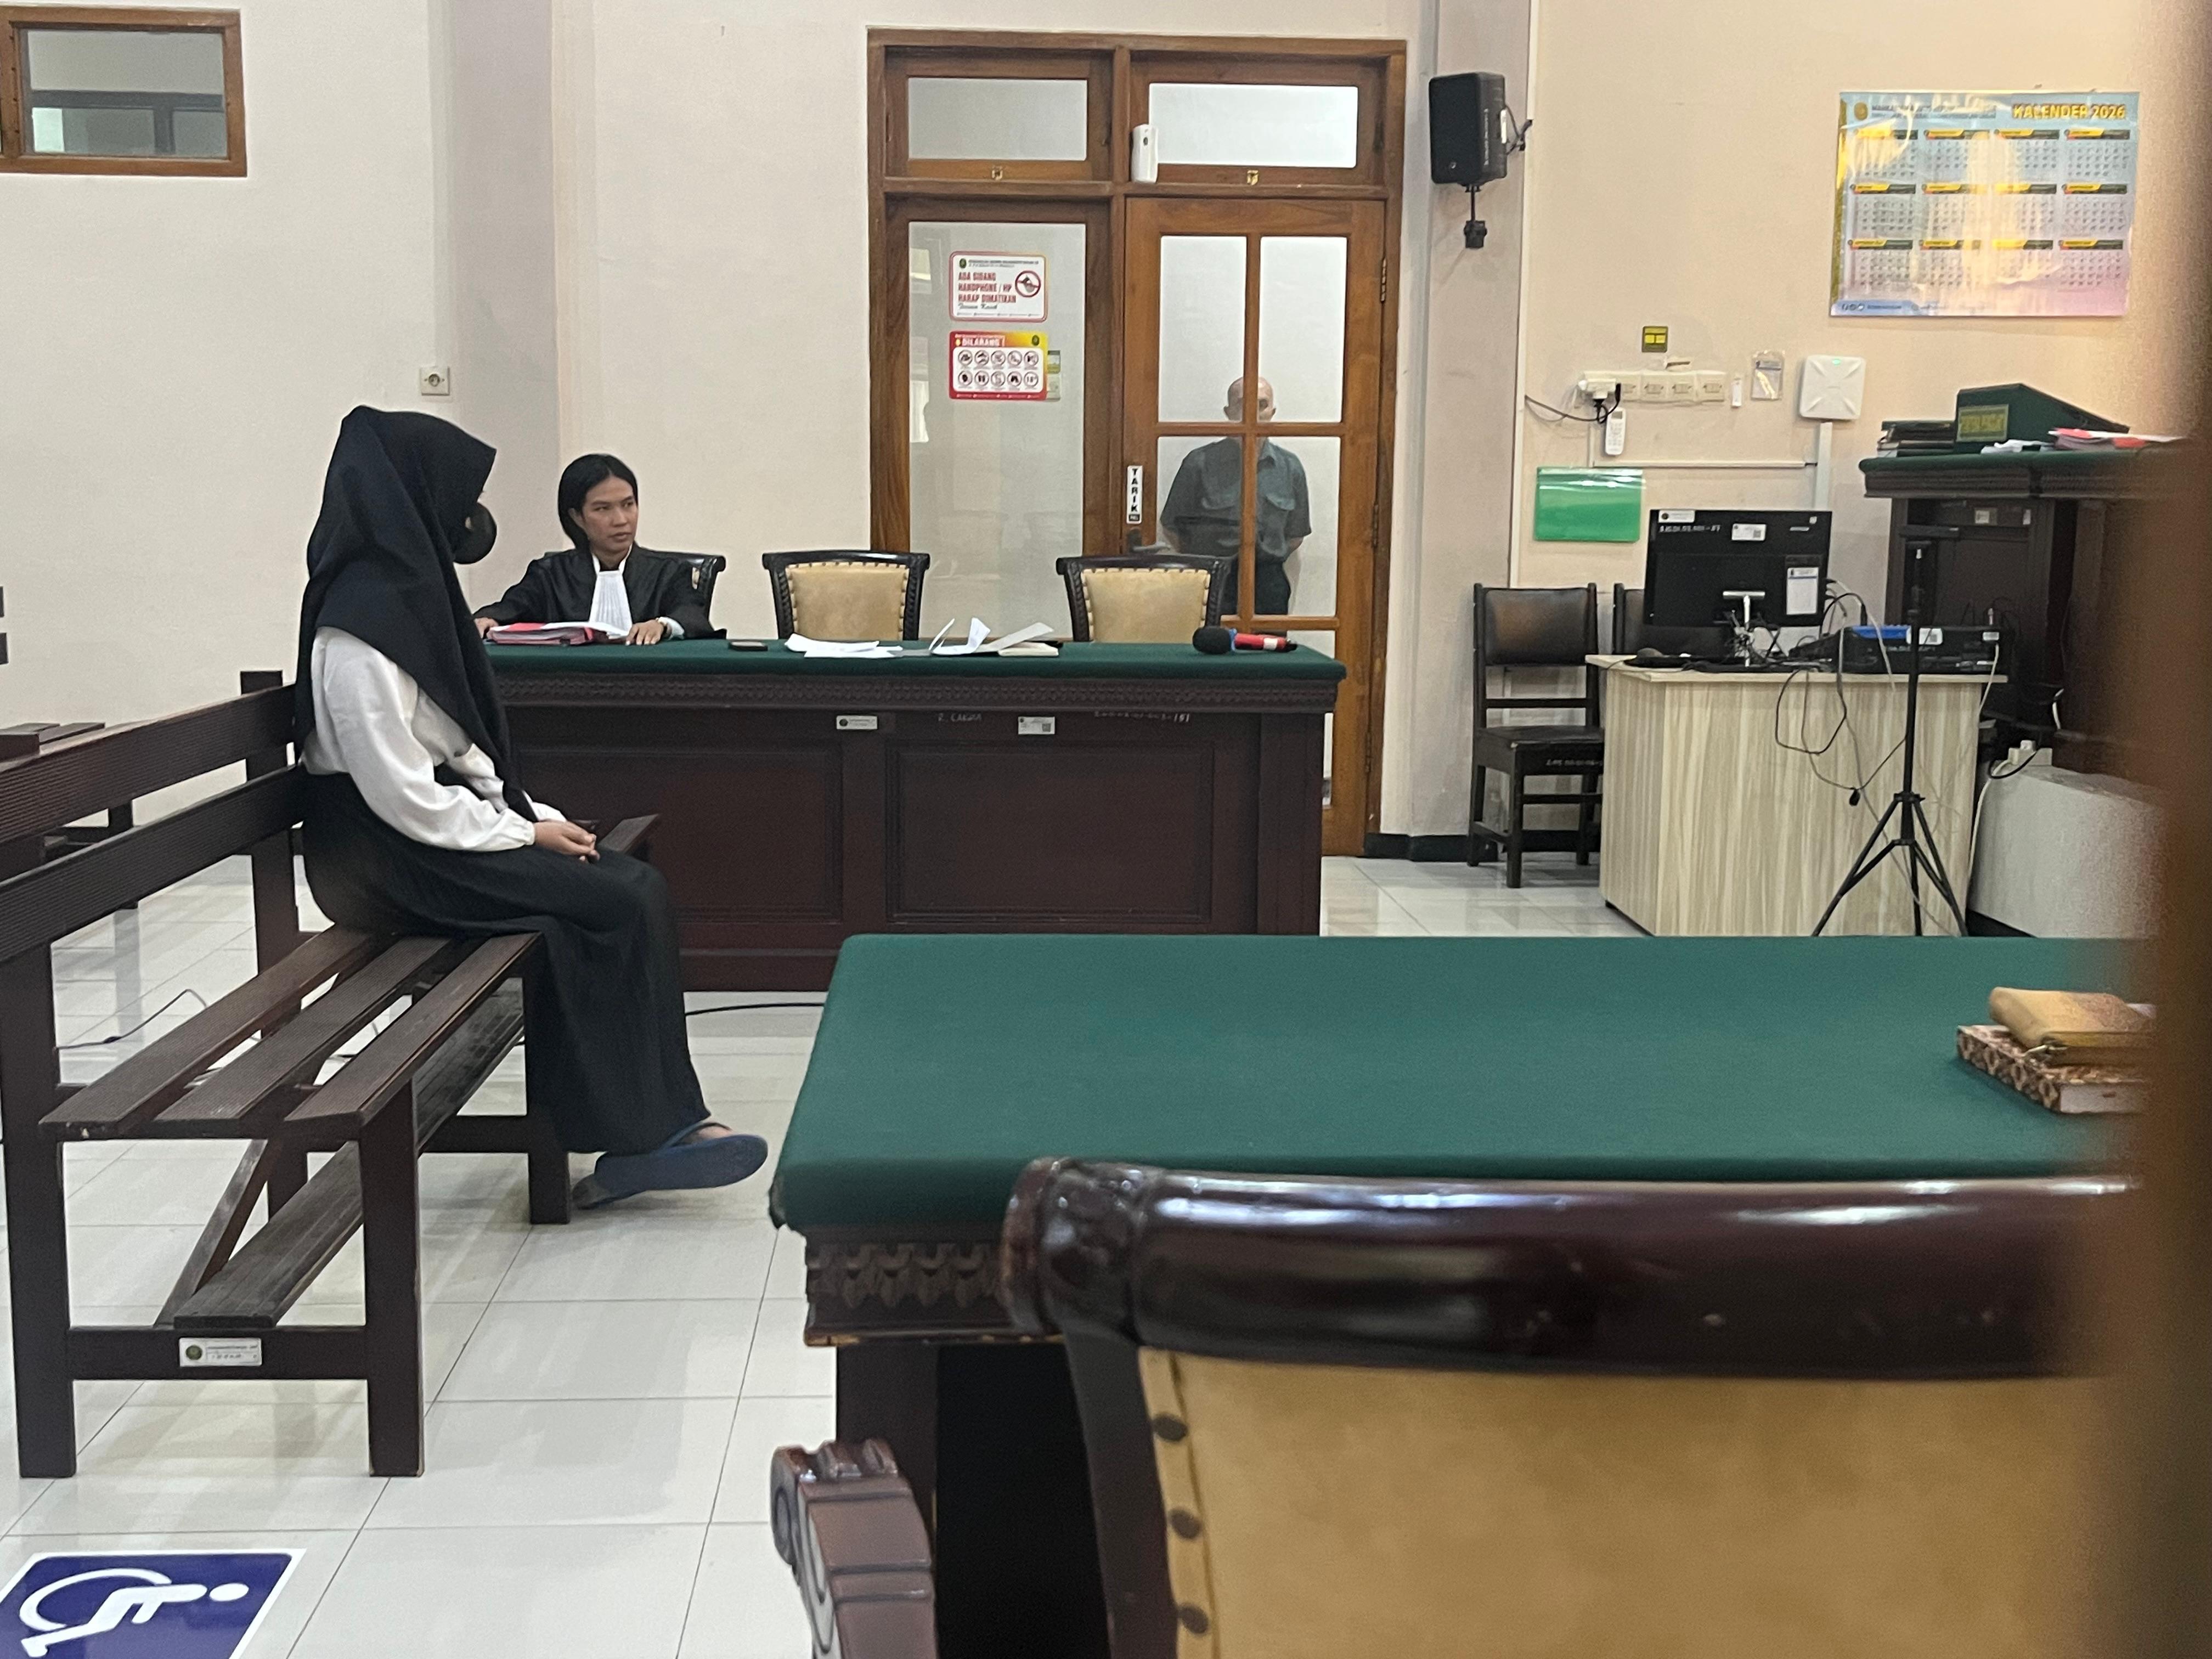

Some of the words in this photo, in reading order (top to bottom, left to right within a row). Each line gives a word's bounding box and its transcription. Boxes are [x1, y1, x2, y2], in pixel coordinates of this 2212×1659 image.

[2013, 103, 2088, 119] KALENDER
[2090, 104, 2126, 120] 2026
[962, 337, 1000, 346] DILARANG
